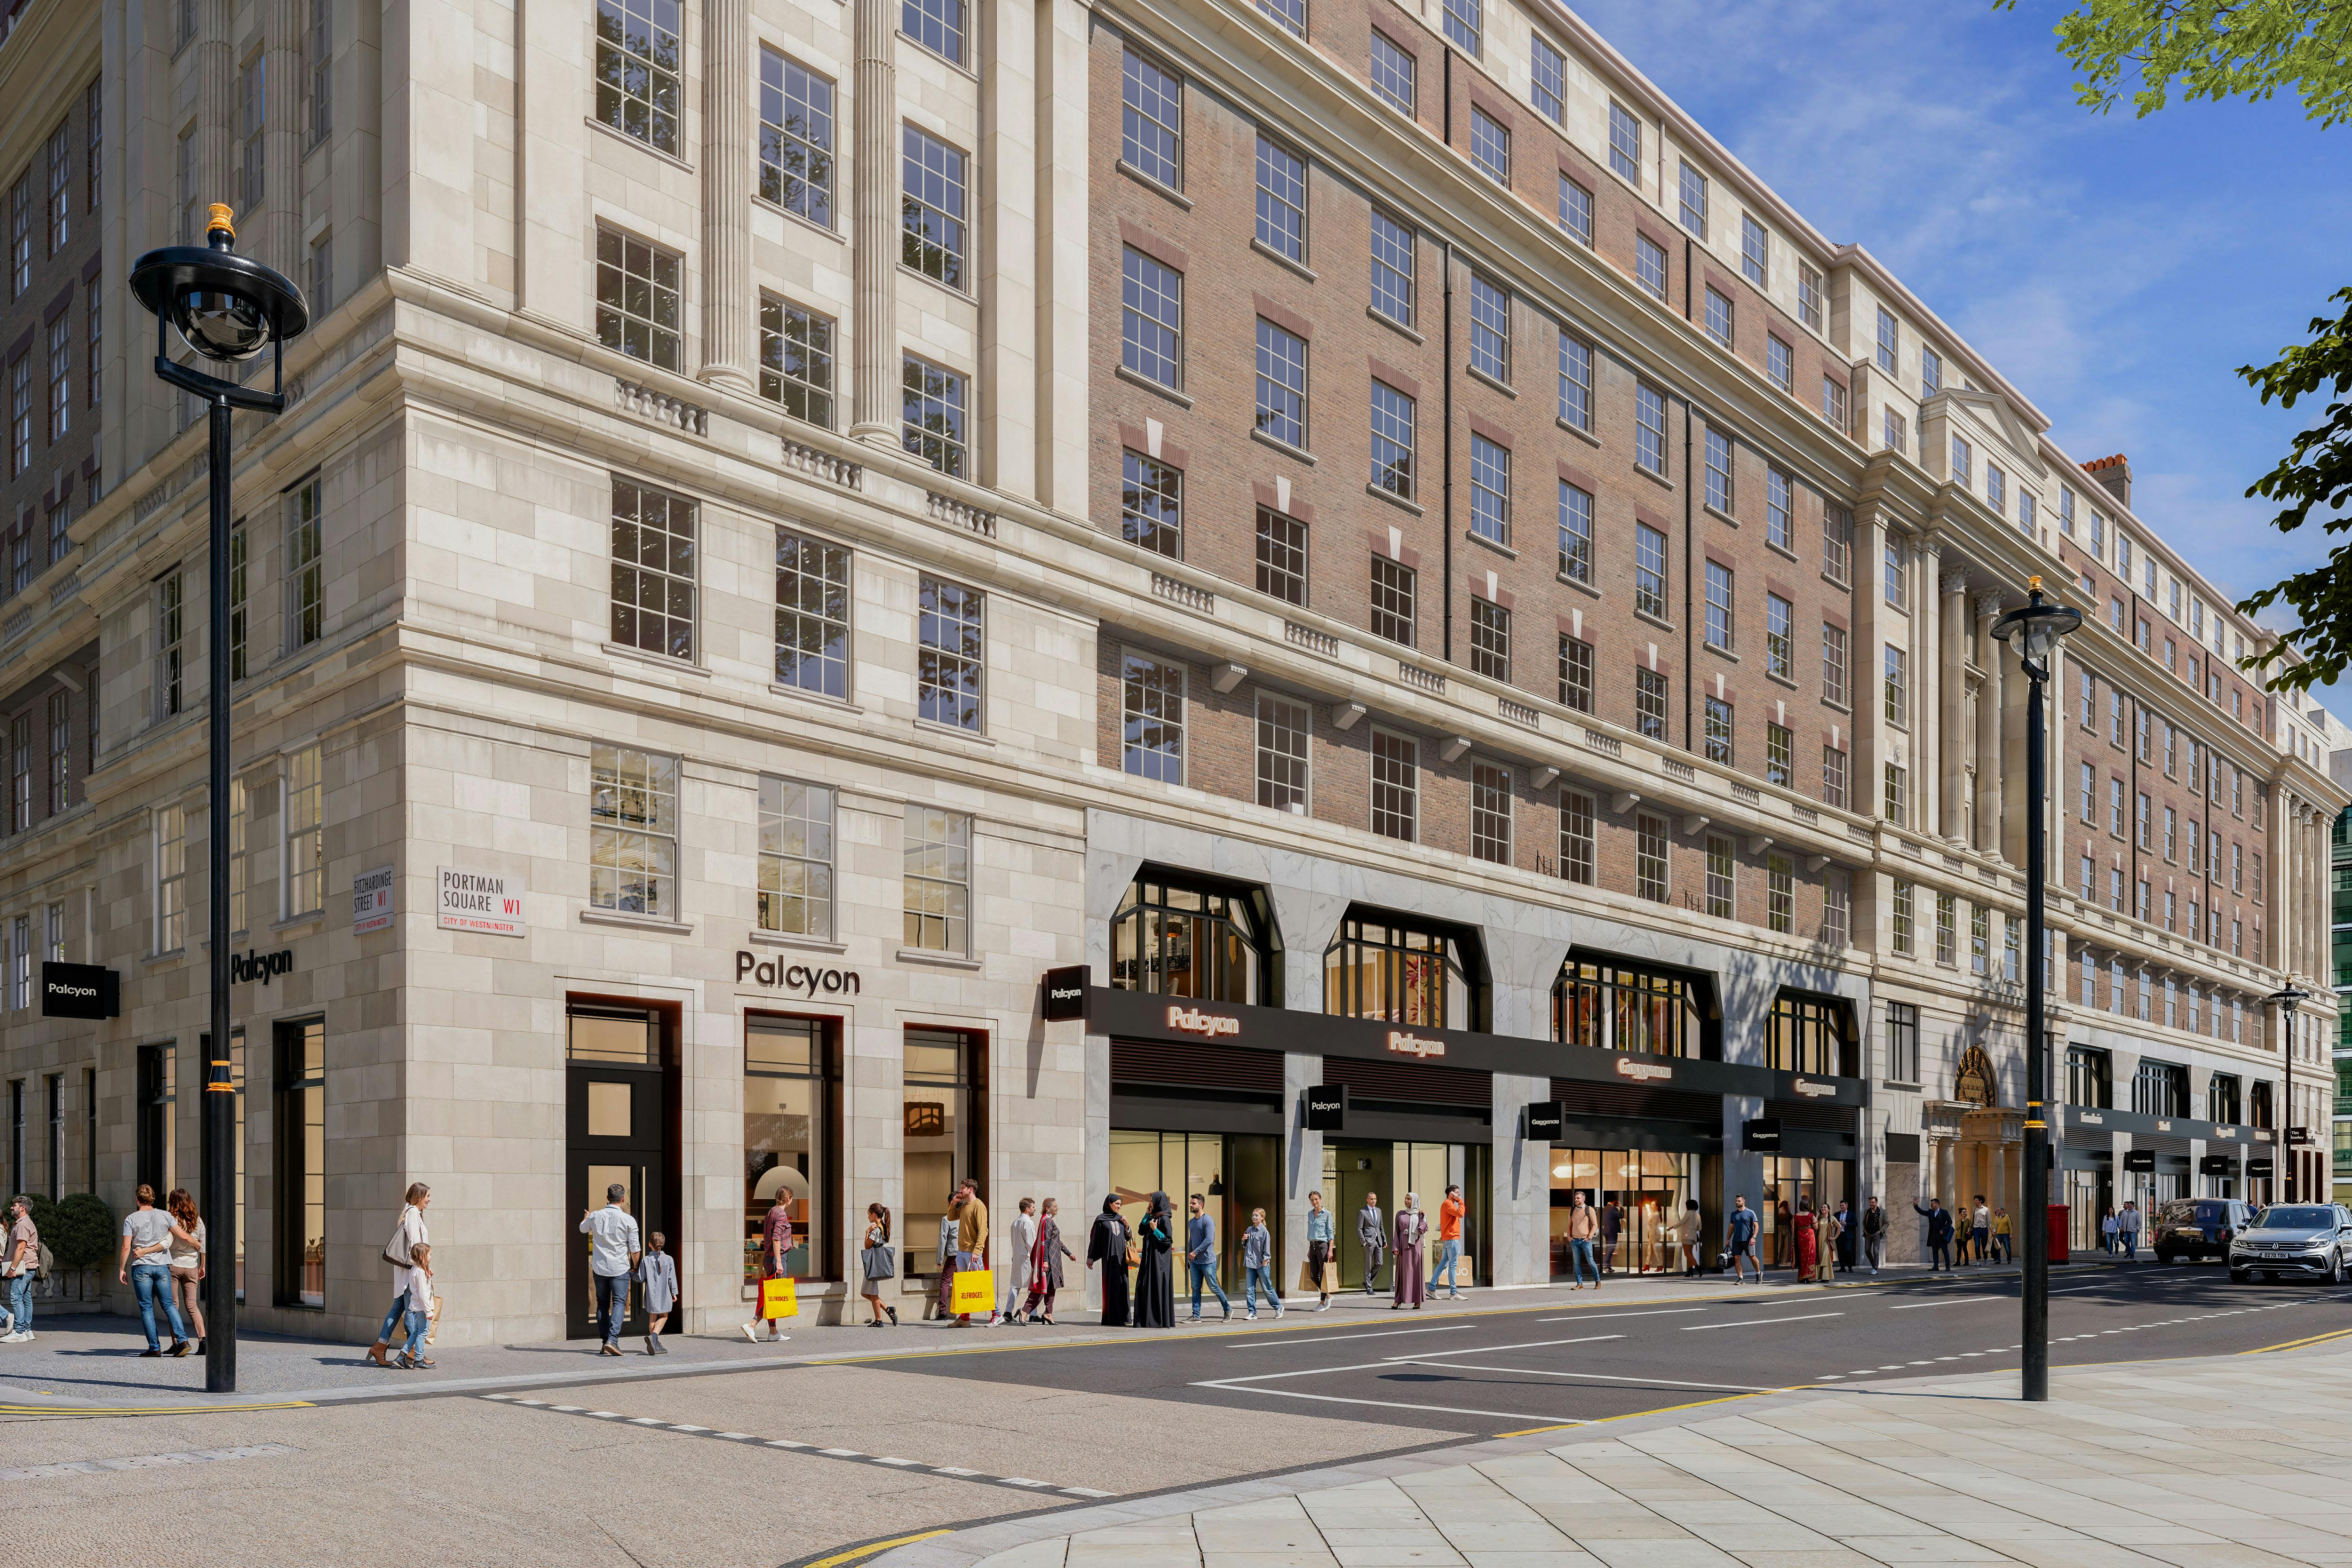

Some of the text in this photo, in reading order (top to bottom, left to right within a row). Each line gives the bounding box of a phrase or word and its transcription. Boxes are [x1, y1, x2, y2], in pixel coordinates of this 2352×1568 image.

[354, 871, 391, 895] FITZHARDINGE
[444, 872, 503, 895] PORTMAN
[354, 890, 386, 914] STREET W1
[444, 891, 519, 915] SQUARE W1
[366, 917, 387, 929] WESTMINSTER
[444, 917, 458, 925] CITY
[469, 920, 514, 932] WESTMINSTER
[230, 949, 292, 986] Palcyon
[736, 950, 860, 996] Palcyon
[48, 983, 96, 997] Palcyon
[1051, 988, 1081, 999] Palcyon
[1169, 1006, 1239, 1036] Palcyon
[1389, 1031, 1445, 1058] Palcyon
[1618, 1058, 1672, 1080] Gaggenau
[1961, 1077, 1984, 1088] ORCHARD
[1312, 1101, 1340, 1111] Palcyon
